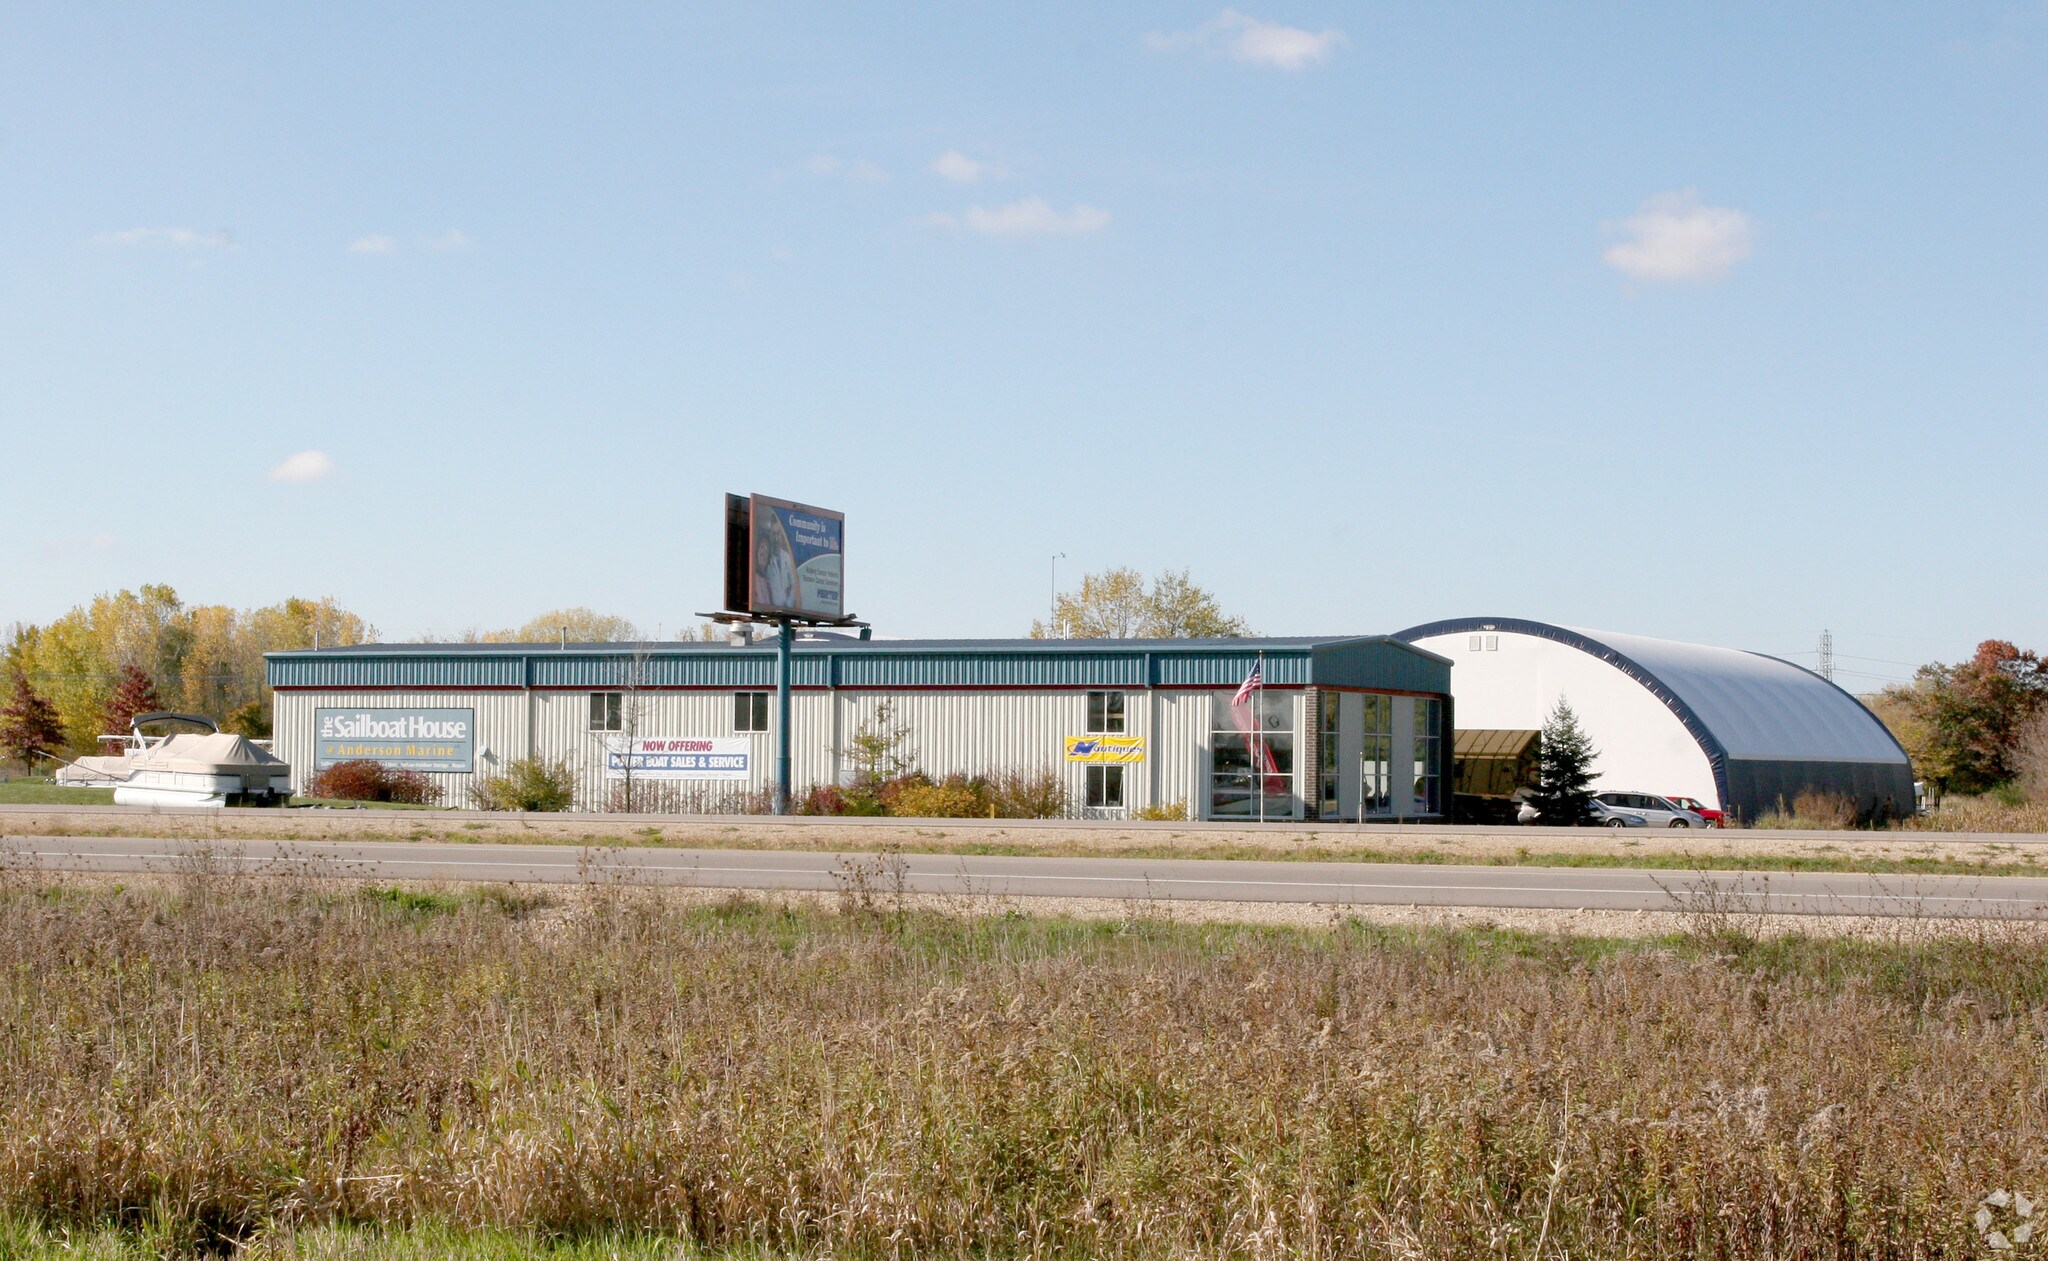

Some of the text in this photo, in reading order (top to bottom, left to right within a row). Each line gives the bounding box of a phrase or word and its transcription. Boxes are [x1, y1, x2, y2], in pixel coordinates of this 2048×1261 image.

[789, 515, 826, 533] Community is
[795, 531, 822, 547] Important
[823, 537, 829, 548] to
[321, 714, 466, 738] the Sailboat House
[338, 744, 401, 756] Anderson
[406, 745, 455, 756] Marine
[642, 740, 713, 752] NOW OFFERING
[1069, 741, 1143, 756] Nautiques
[645, 756, 669, 767] BOAT
[670, 756, 697, 768] SALES
[698, 756, 706, 768] &
[708, 756, 744, 768] SERVICE
